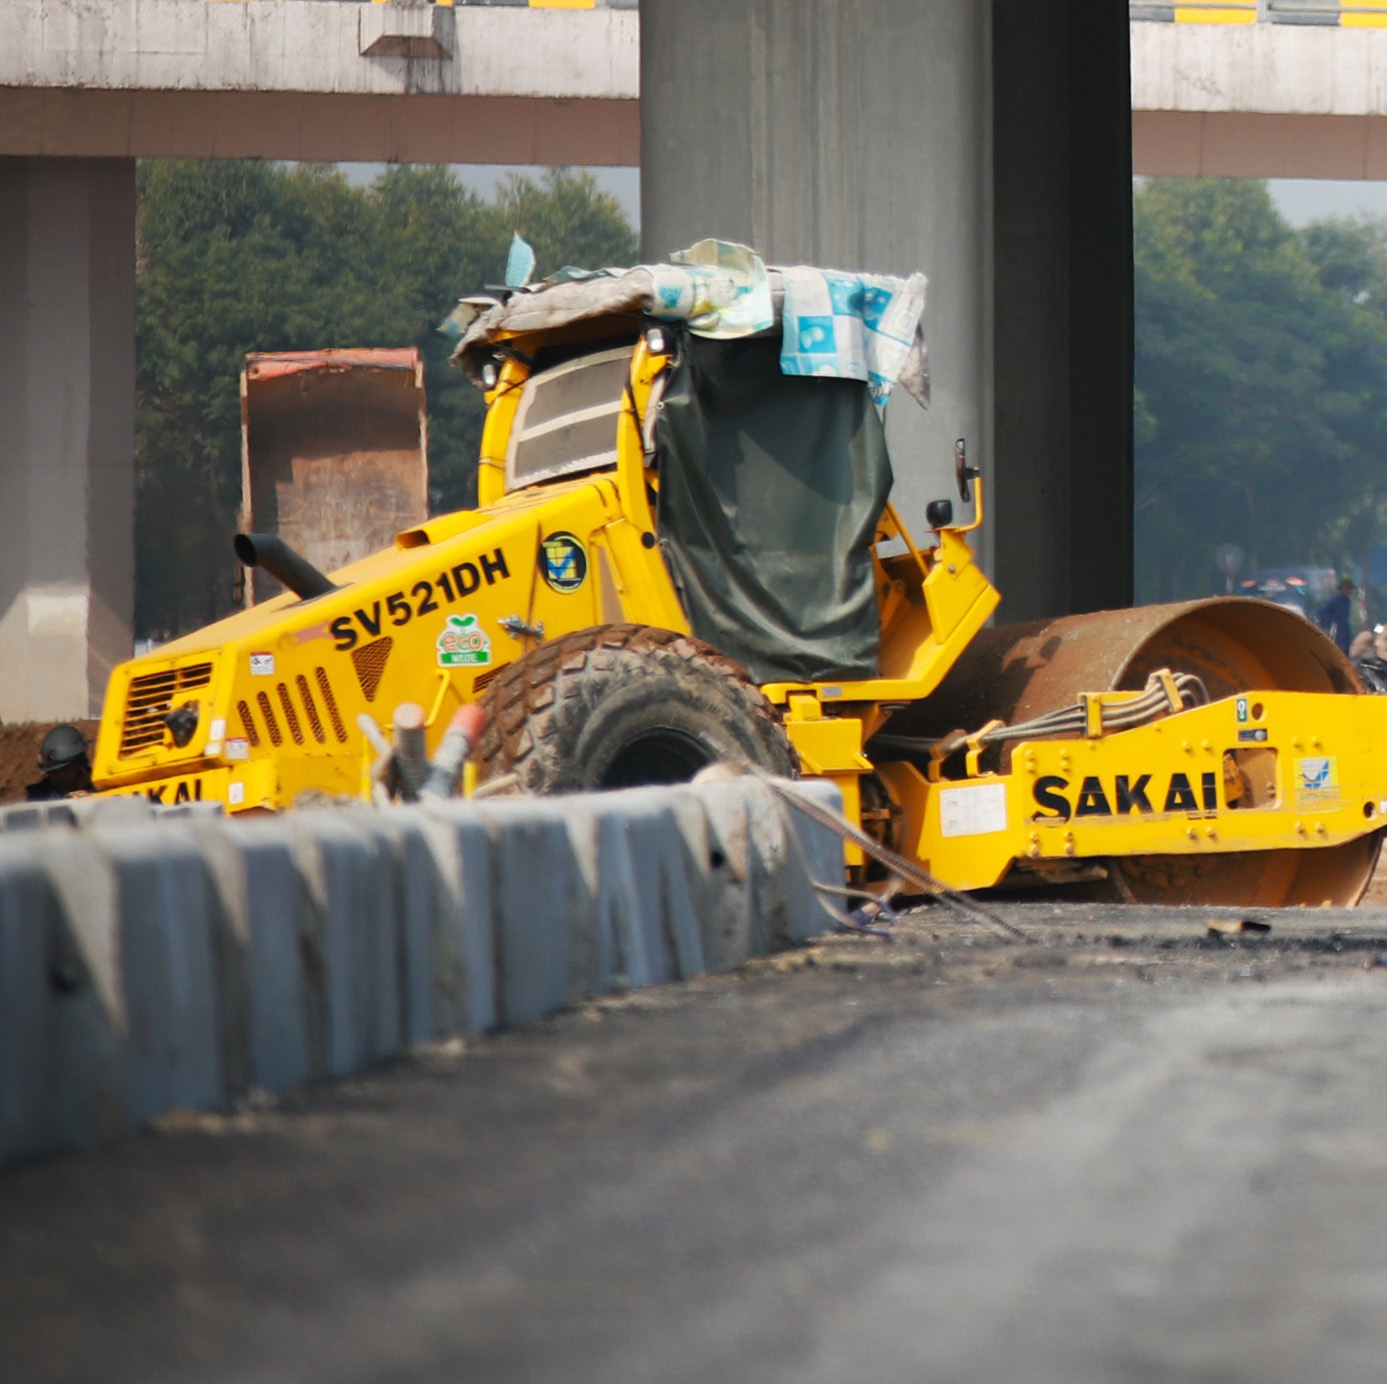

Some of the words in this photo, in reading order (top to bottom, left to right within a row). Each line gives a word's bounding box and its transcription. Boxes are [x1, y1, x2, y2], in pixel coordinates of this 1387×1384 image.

[329, 547, 511, 652] SV521DH
[443, 631, 484, 652] eco
[1031, 771, 1218, 828] SAKAI
